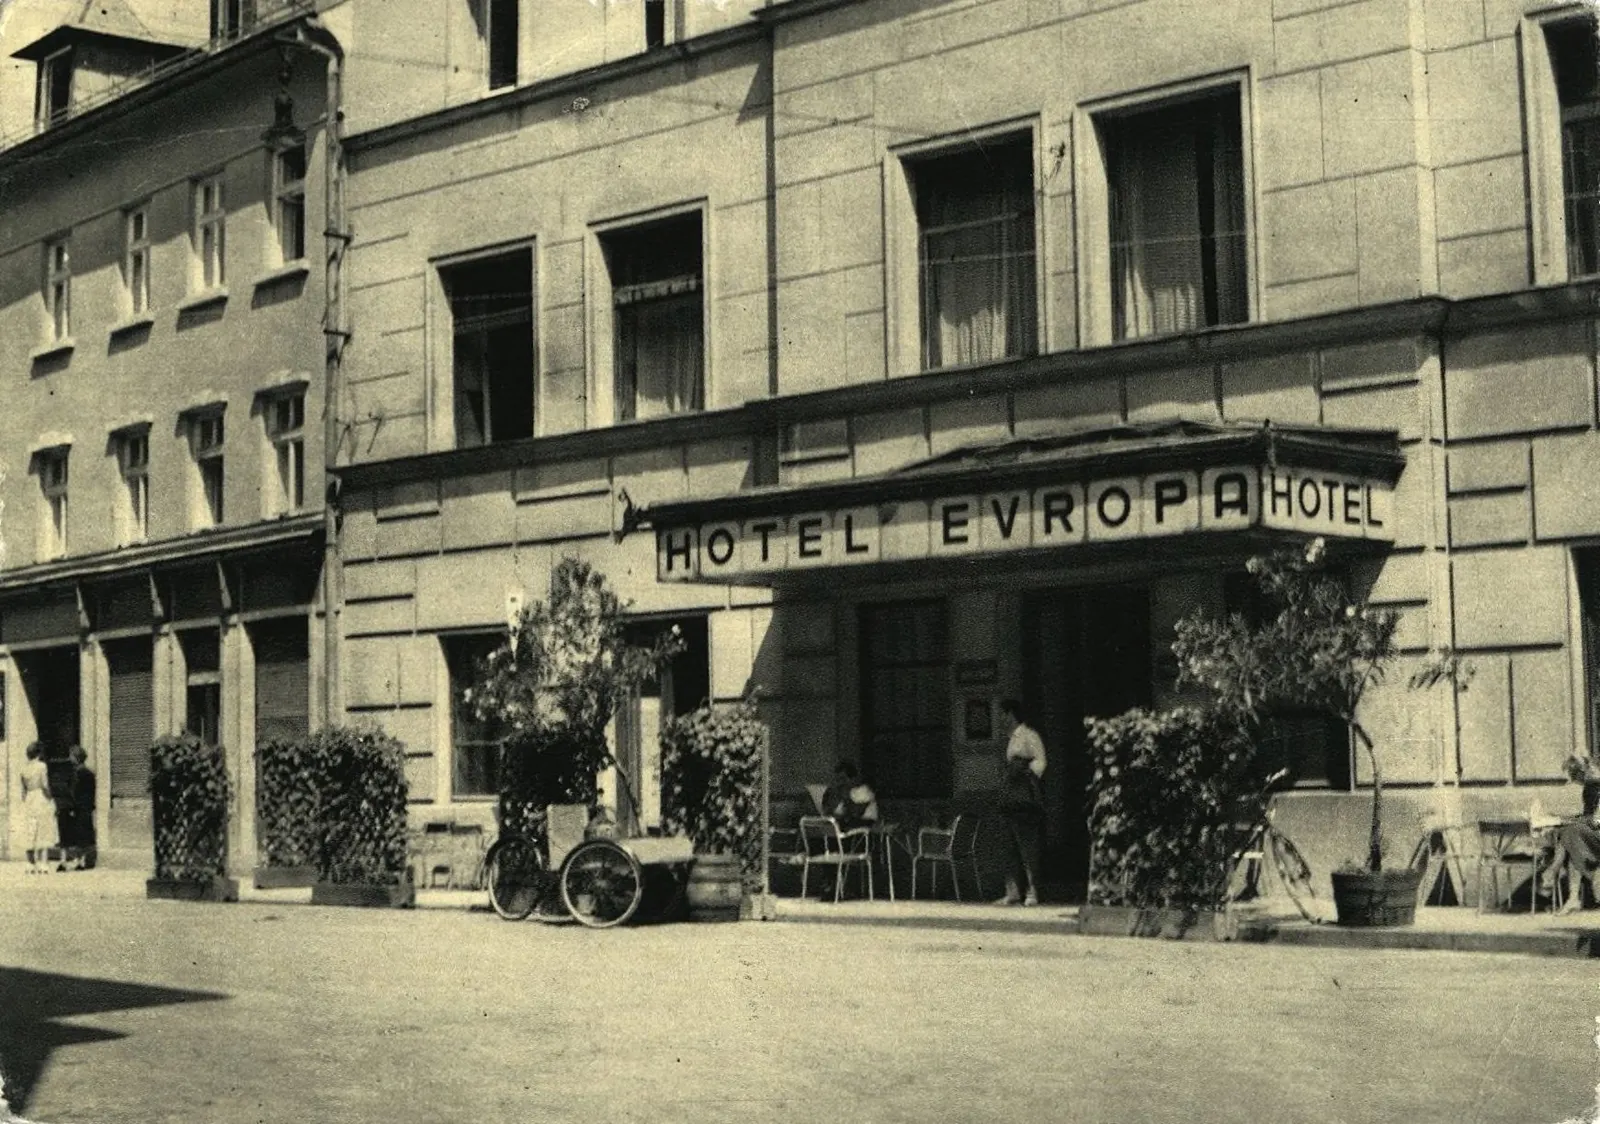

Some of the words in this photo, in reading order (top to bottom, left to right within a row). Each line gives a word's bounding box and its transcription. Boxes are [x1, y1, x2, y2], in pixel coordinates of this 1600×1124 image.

[666, 514, 869, 571] HOTEL
[942, 473, 1248, 545] EVROPA
[1270, 473, 1383, 528] HOTEL
